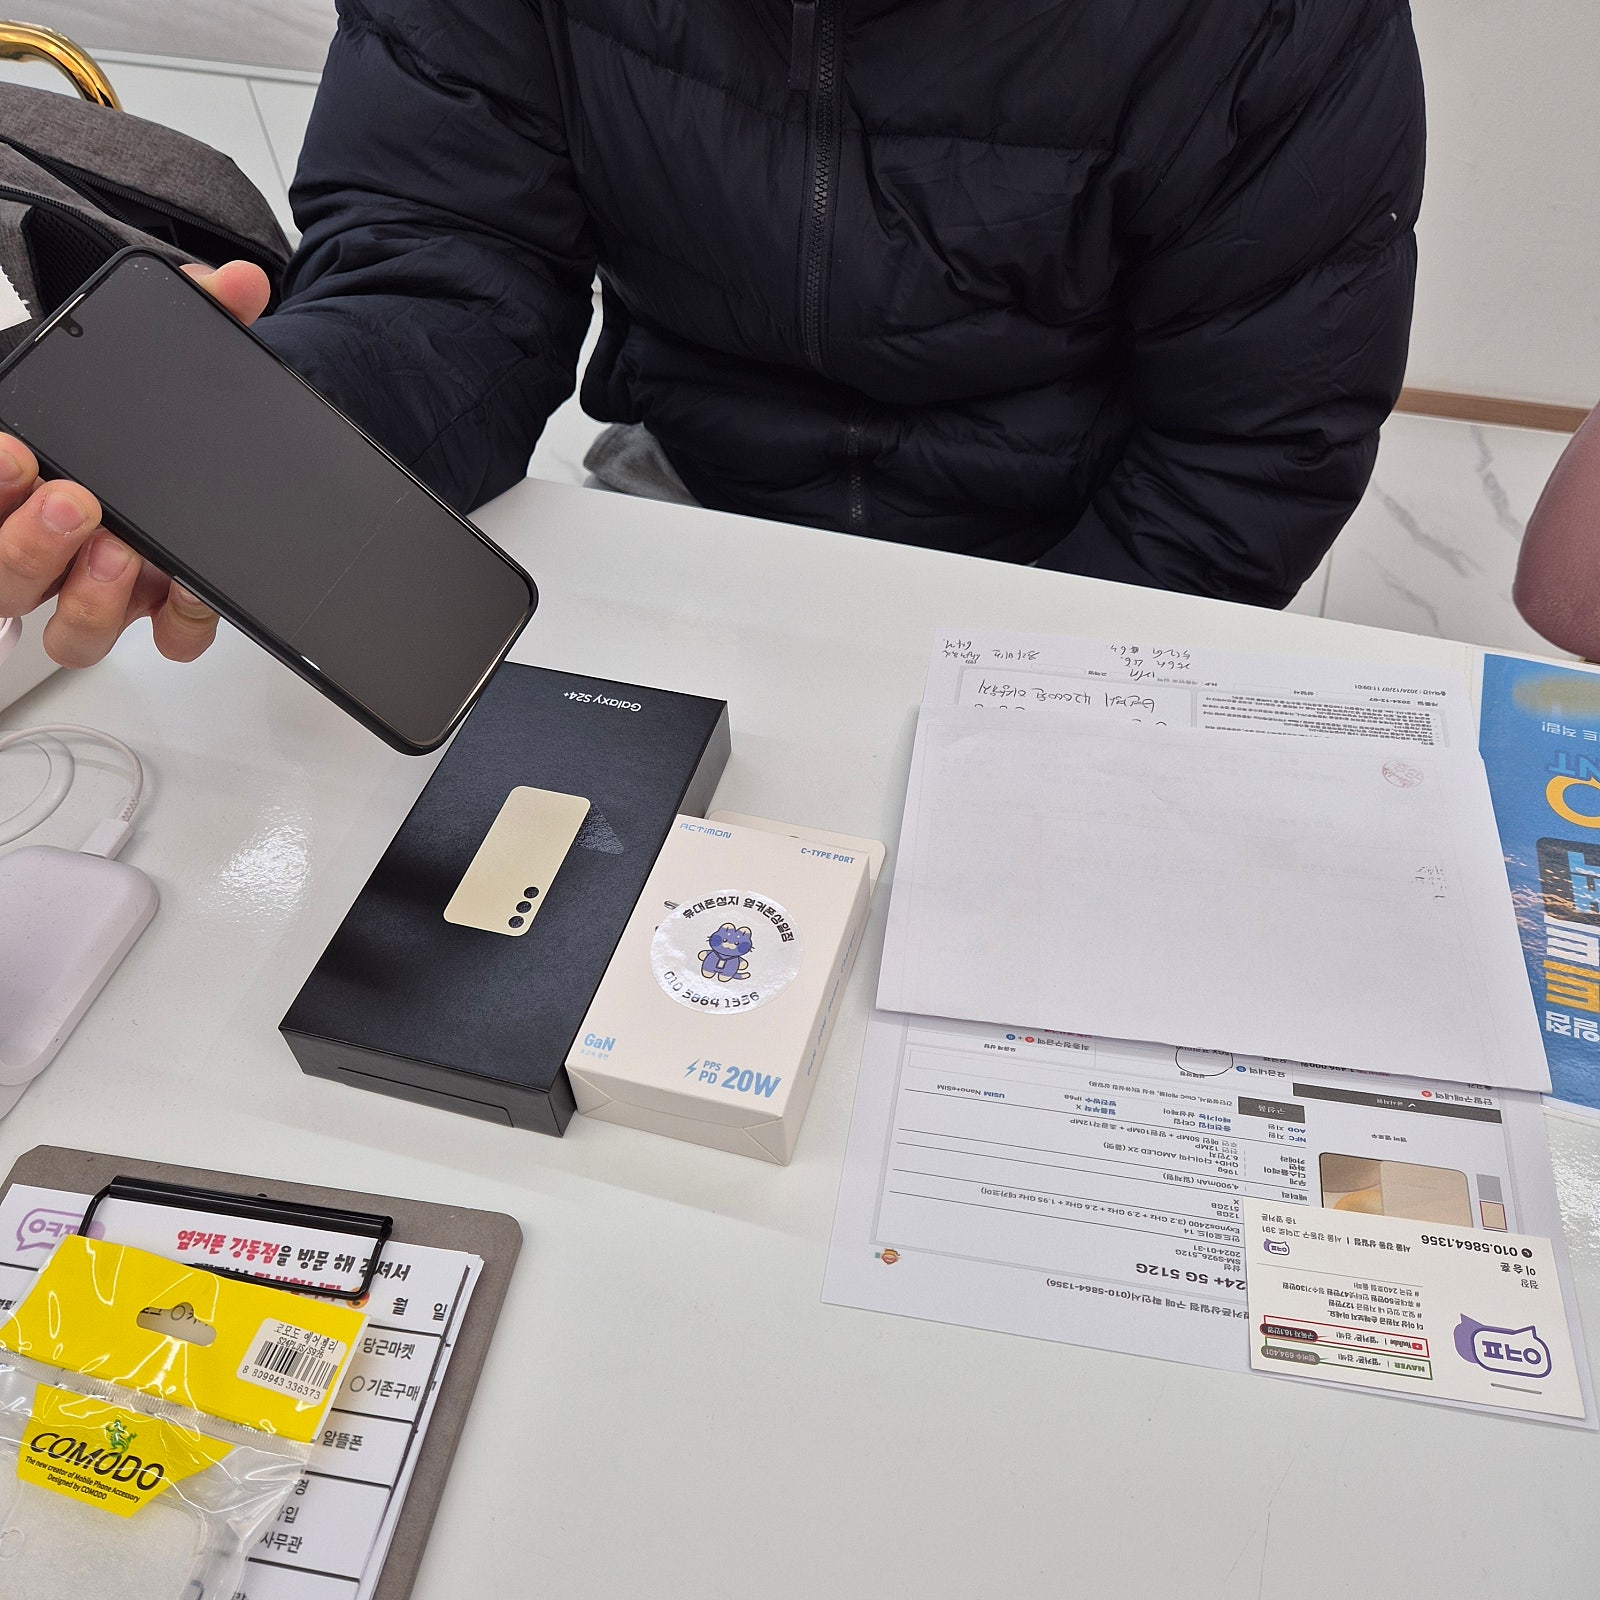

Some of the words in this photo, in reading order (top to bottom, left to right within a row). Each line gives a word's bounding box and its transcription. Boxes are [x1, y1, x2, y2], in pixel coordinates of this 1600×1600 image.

[1381, 686, 1418, 695] 2024/12/07
[563, 691, 593, 703] S24+
[1369, 697, 1412, 705] 2024-12-07
[592, 694, 642, 712] Galaxy
[1542, 721, 1577, 738] 적립!
[800, 847, 831, 860] C-TYPE
[832, 853, 856, 865] PORT
[682, 896, 740, 920] 휴대폰성지
[743, 897, 796, 943] 옆커폰상일점
[584, 1033, 616, 1051] GaN
[703, 1060, 723, 1072] PPS
[1249, 1067, 1286, 1079] 요금내역
[698, 1070, 717, 1084] PD
[721, 1066, 782, 1098] 20W
[983, 1091, 1006, 1099] USIM
[1435, 1092, 1493, 1106] 단말구매내역
[1257, 1104, 1286, 1115] 구성품
[1267, 1123, 1284, 1131] 지원
[1176, 1133, 1200, 1142] 50MP
[1268, 1132, 1284, 1140] 지원
[1195, 1142, 1219, 1151] 12MP
[1140, 1148, 1177, 1159] AMOLED
[1209, 1152, 1239, 1161] 6.7인치
[1280, 1155, 1305, 1165] 카메라
[1217, 1166, 1239, 1176] 196g
[1263, 1166, 1306, 1179] 디스플레이
[1163, 1171, 1195, 1184] (일체형)
[1018, 1192, 1036, 1202] GHz
[1038, 1195, 1056, 1205] 1.95
[1282, 1191, 1308, 1201] 배터리
[1065, 1200, 1083, 1208] GHz
[1084, 1203, 1098, 1211] 2.6
[1211, 1201, 1240, 1212] 512GB
[1108, 1206, 1126, 1215] GHz
[1126, 1210, 1140, 1218] 2.9
[1216, 1209, 1240, 1219] 12GB
[1150, 1213, 1169, 1222] GHz
[1170, 1217, 1187, 1226] (3.2
[1285, 1216, 1297, 1225] 1층
[1189, 1220, 1241, 1234] Exynos2400
[1262, 1225, 1276, 1233] 391
[1277, 1227, 1301, 1236] 고덕로
[1197, 1230, 1241, 1243] 안드로이드
[1302, 1230, 1325, 1240] 강동구
[1327, 1233, 1342, 1242] 서울
[1353, 1237, 1377, 1248] 상일점
[1378, 1240, 1394, 1250] 강동
[1420, 1235, 1518, 1257] 010.5864.1356
[177, 1230, 227, 1256] 옆커폰
[230, 1238, 293, 1268] 강동점을
[297, 1248, 331, 1271] 방문
[333, 1253, 356, 1275] 해
[1193, 1245, 1241, 1257] 2024-01-31
[1396, 1244, 1411, 1253] 서울
[1175, 1249, 1241, 1264] SM-S926_512G
[1136, 1263, 1180, 1279] 512G
[1223, 1264, 1241, 1272] 삼성
[1185, 1271, 1209, 1284] 5G
[1282, 1281, 1326, 1295] 정수기30만원
[1370, 1284, 1398, 1294] 240호점
[1521, 1278, 1540, 1290] 점장
[1046, 1278, 1163, 1306] 확인서(010-5864-1356)
[1326, 1288, 1370, 1301] 인터넷47만원
[1399, 1288, 1413, 1297] 전국
[1165, 1297, 1187, 1309] 구매
[1327, 1299, 1355, 1310] 127만원
[1370, 1294, 1414, 1308] 휴대폰50만원
[392, 1297, 409, 1317] 월
[432, 1301, 450, 1322] 일
[1355, 1302, 1376, 1313] 지원금
[1377, 1305, 1385, 1314] 내
[1327, 1309, 1350, 1320] 마세요.
[1351, 1312, 1378, 1323] 손해보지
[1379, 1316, 1400, 1327] 지원금
[1401, 1320, 1416, 1330] 이상
[1415, 1322, 1424, 1331] 더
[1336, 1331, 1353, 1341] 검색!
[363, 1337, 416, 1360] 당근마켓
[1389, 1338, 1412, 1350] YouTube
[1266, 1348, 1294, 1359] 694,401
[1337, 1353, 1355, 1363] 검색!
[1394, 1361, 1425, 1373] NAVER
[241, 1365, 250, 1374] 8
[251, 1369, 286, 1387] 809943
[285, 1381, 321, 1400] 336373
[366, 1377, 422, 1402] 기존구매
[323, 1430, 364, 1452] 알뜰폰
[30, 1432, 165, 1491] COMODO
[25, 1456, 36, 1465] The
[34, 1460, 48, 1470] new
[47, 1464, 67, 1477] creator
[67, 1470, 75, 1479] of
[74, 1472, 93, 1486] Mobile
[92, 1479, 112, 1492] Phone
[111, 1486, 141, 1504] Accessory
[47, 1473, 72, 1488] Designed
[71, 1481, 81, 1492] by
[80, 1485, 108, 1500] COMODO
